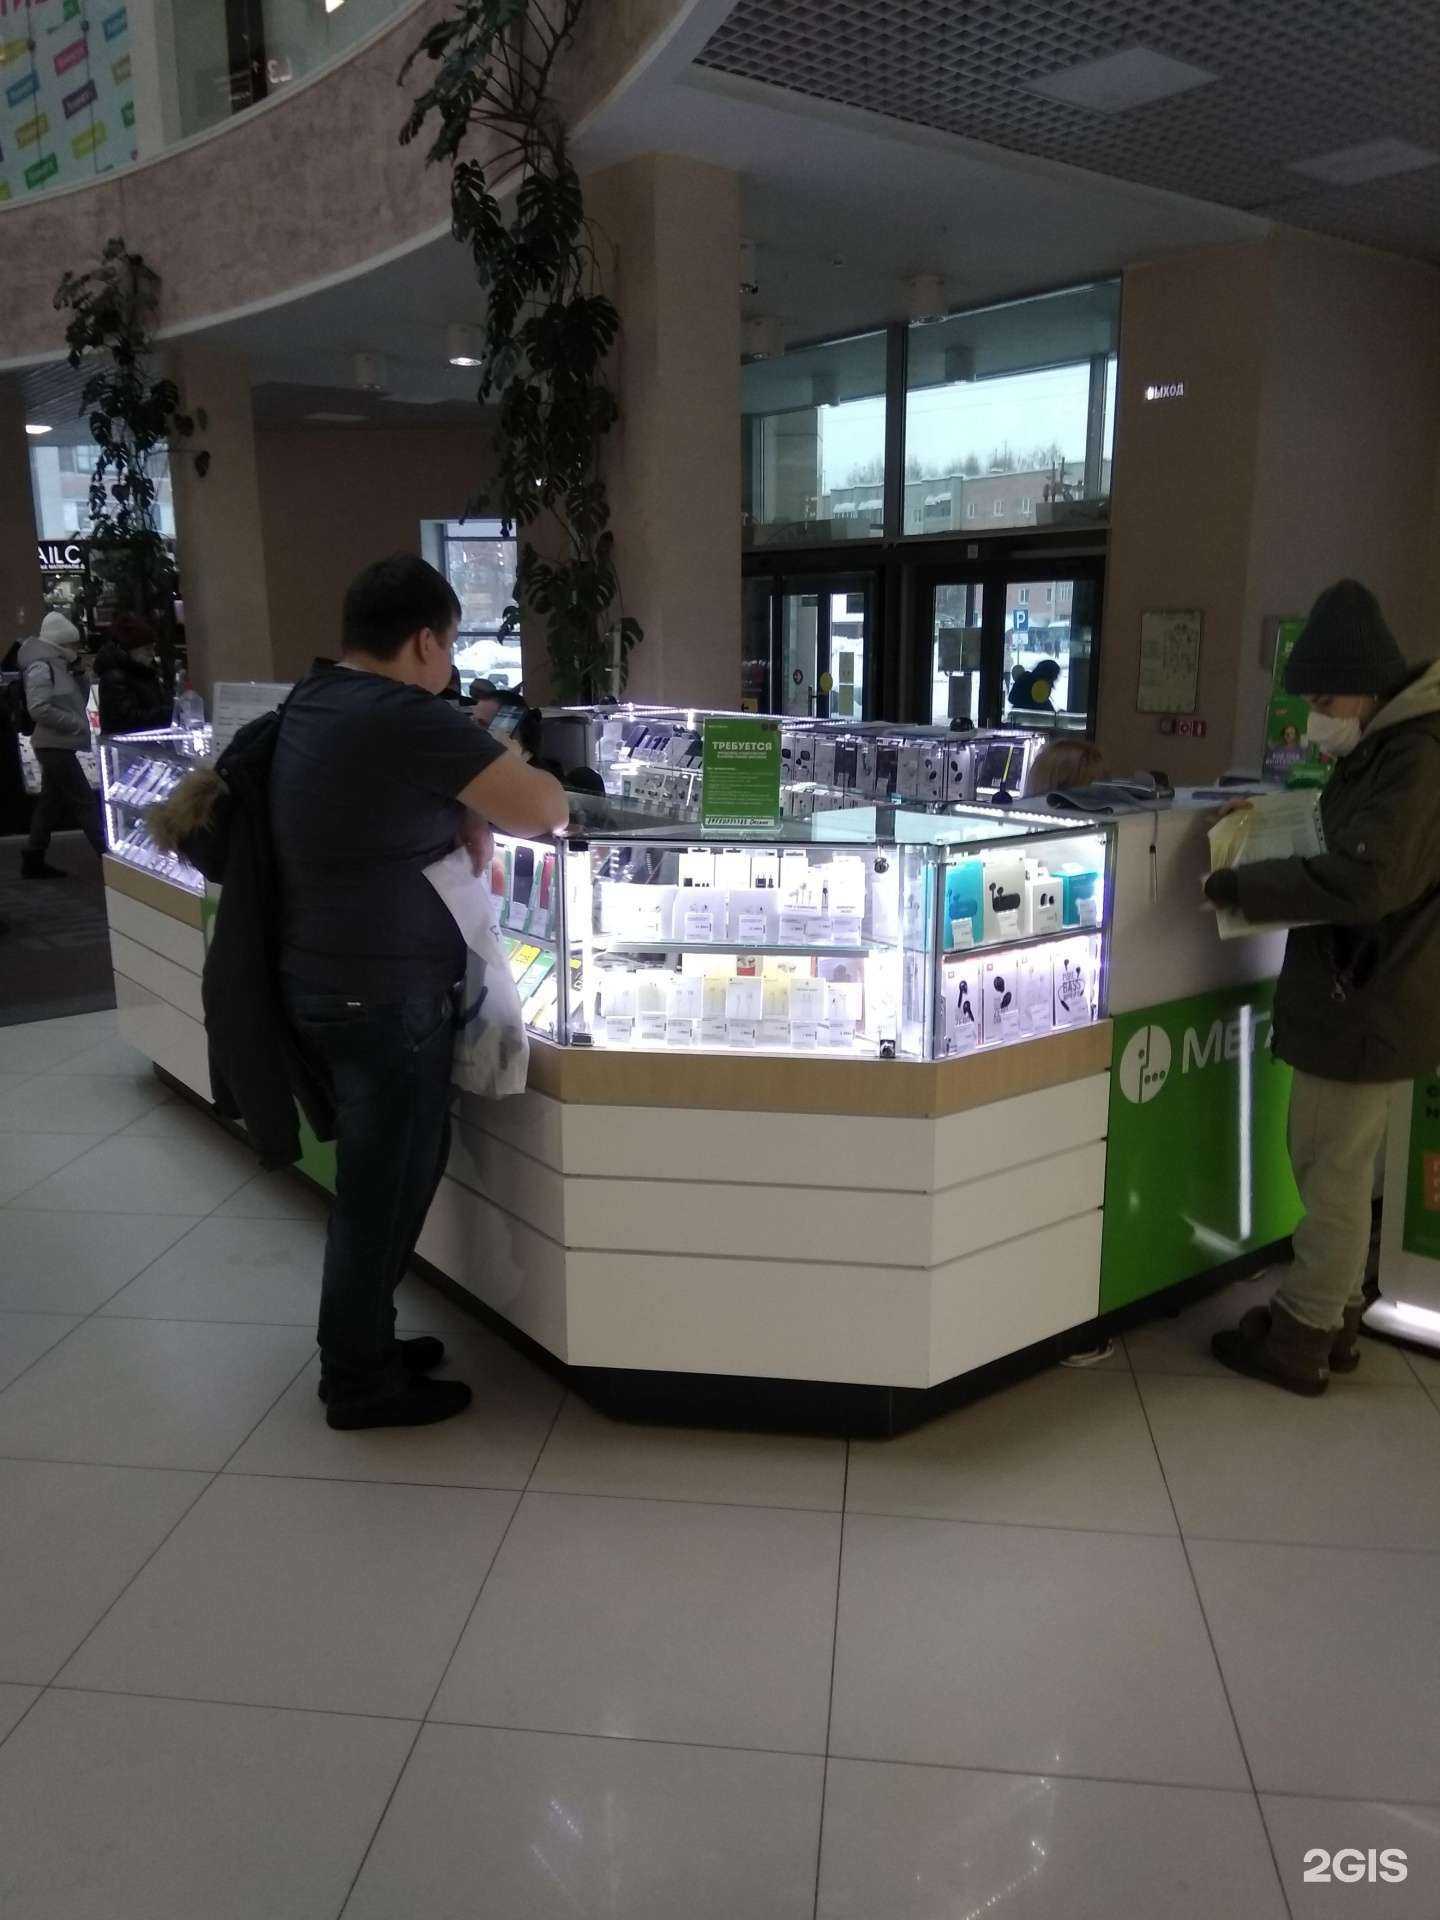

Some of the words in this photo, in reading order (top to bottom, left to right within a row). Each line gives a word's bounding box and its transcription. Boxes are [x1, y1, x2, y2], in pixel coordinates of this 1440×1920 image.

[1146, 382, 1184, 400] ВЫХОД
[1016, 611, 1026, 629] P
[712, 741, 772, 751] ТРЕБУЕТСЯ
